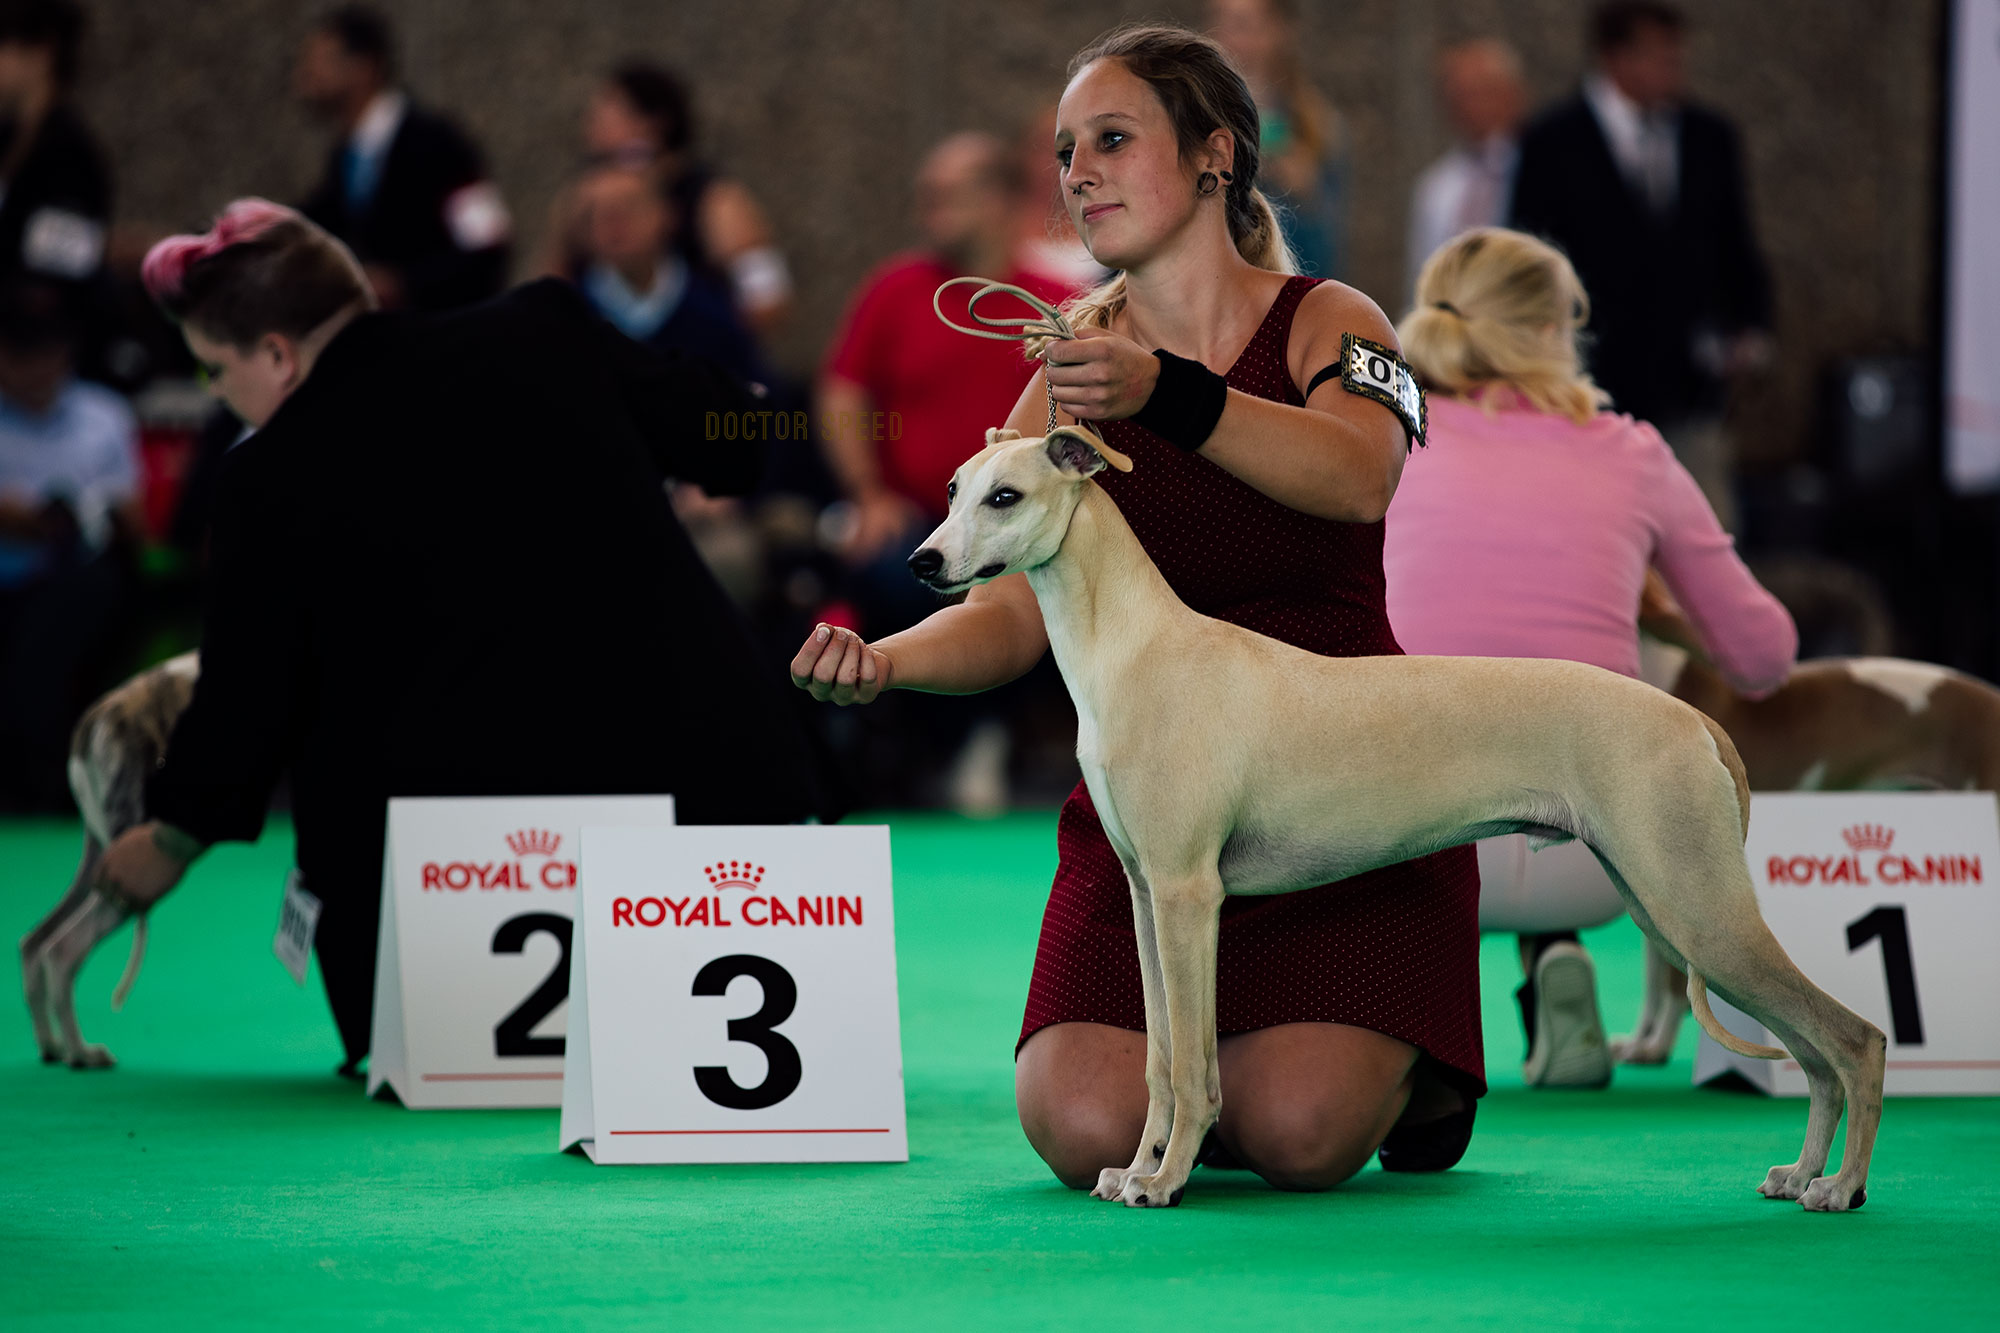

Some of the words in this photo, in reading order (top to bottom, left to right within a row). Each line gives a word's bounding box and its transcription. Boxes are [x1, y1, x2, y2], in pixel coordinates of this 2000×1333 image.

[421, 861, 531, 892] ROYAL
[612, 896, 731, 927] ROYAL
[741, 896, 863, 927] CANIN
[1766, 855, 1868, 886] ROYAL
[1876, 855, 1983, 886] CANIN
[490, 912, 572, 1058] 2
[1845, 903, 1925, 1046] 1
[691, 954, 802, 1110] 3
